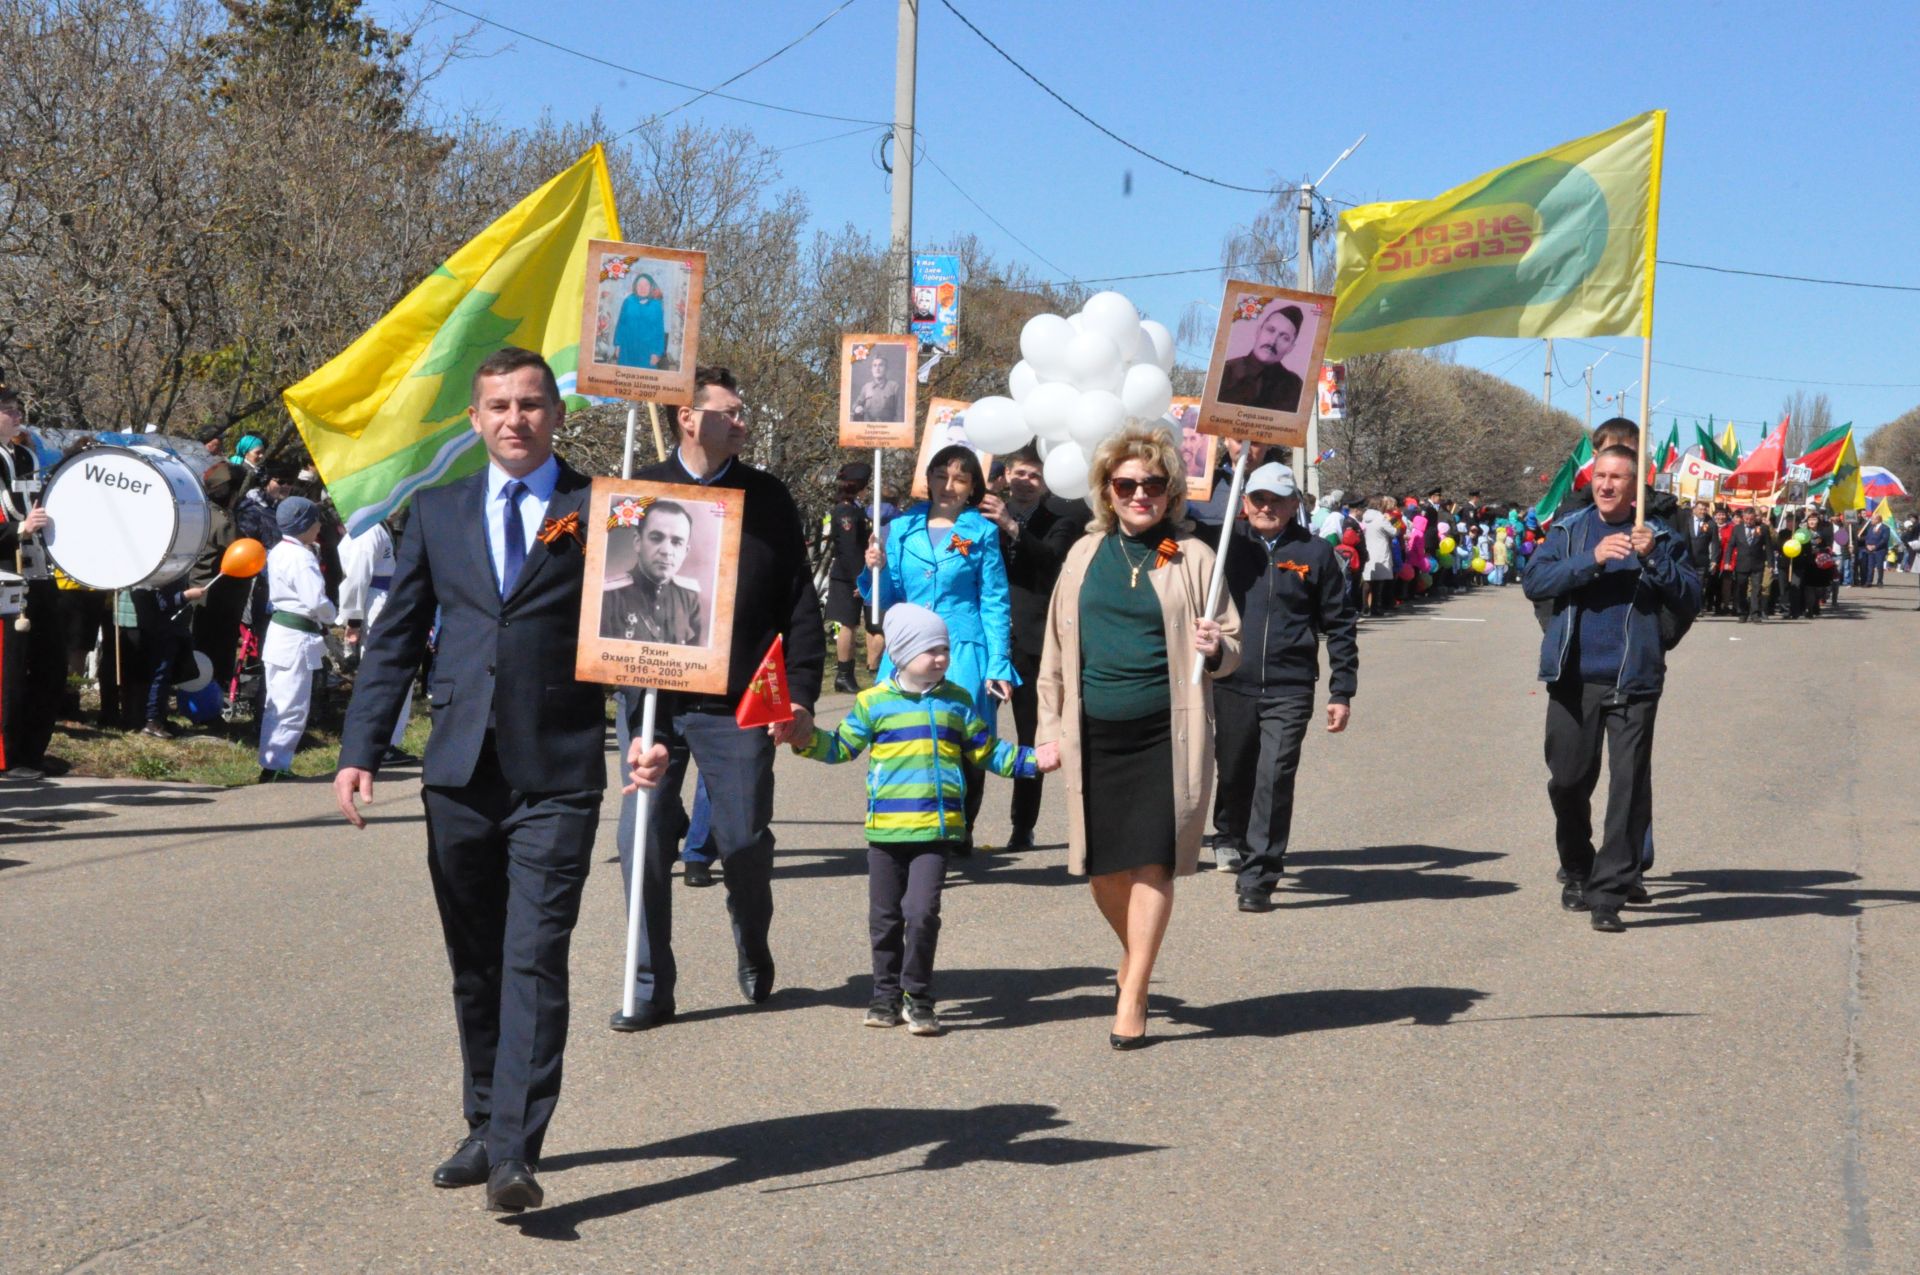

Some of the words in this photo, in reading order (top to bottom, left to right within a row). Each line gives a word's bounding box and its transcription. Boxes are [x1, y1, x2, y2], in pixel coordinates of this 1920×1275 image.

[614, 388, 632, 396] 1922
[639, 390, 657, 398] 2007
[85, 463, 152, 495] Weber
[641, 646, 669, 657] Яхин
[638, 655, 681, 668] Бадыйк
[684, 661, 708, 671] улы
[624, 664, 648, 675] 1916
[659, 668, 683, 678] 2003
[616, 675, 629, 683] ст.
[632, 675, 690, 688] лейтенант
